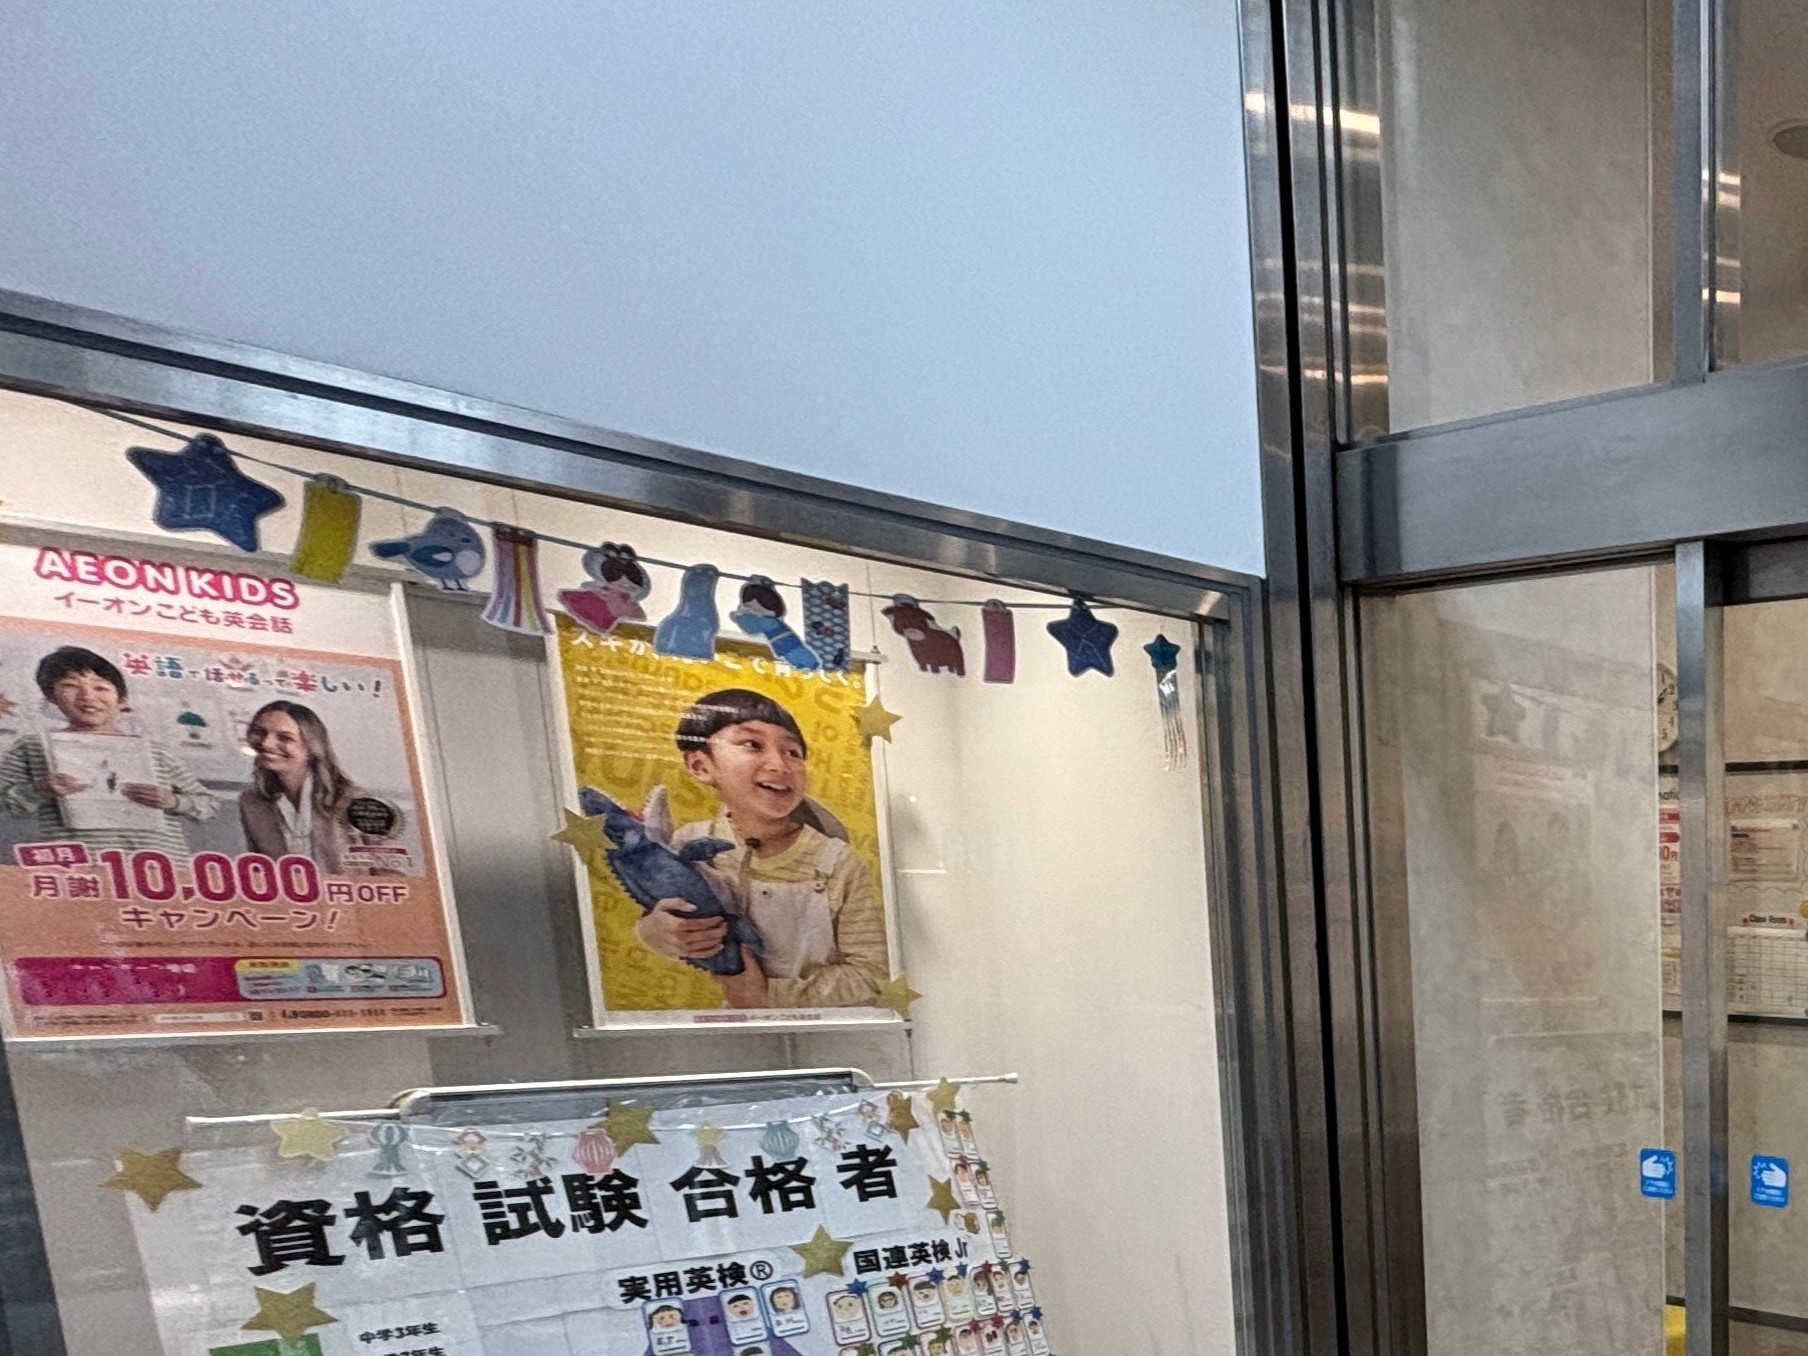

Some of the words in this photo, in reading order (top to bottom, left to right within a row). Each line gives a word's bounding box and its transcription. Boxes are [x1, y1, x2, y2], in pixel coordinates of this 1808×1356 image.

[35, 547, 181, 594] AEON
[181, 566, 300, 610] KIDS
[54, 592, 293, 633] イーオンこども英会話
